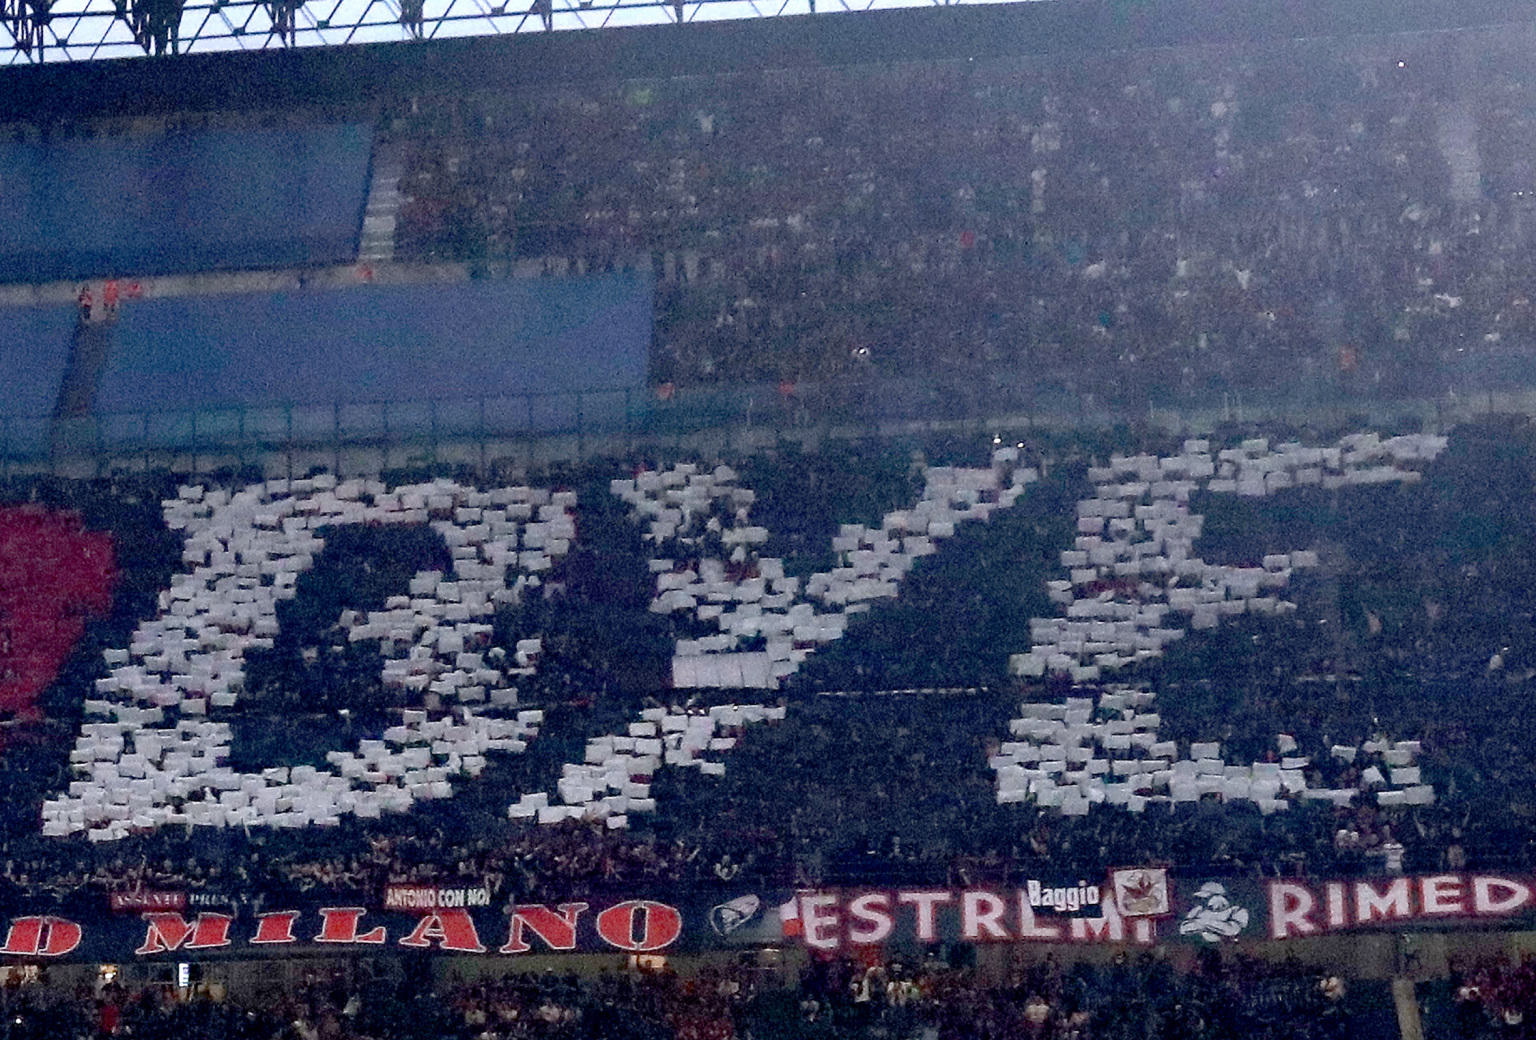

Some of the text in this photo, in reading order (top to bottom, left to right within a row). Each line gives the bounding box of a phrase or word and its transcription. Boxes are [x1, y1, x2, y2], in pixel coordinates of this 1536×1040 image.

[386, 888, 436, 907] ANTONIO
[438, 889, 464, 907] CON
[1027, 879, 1099, 912] Baggio
[134, 900, 682, 957] MILANO
